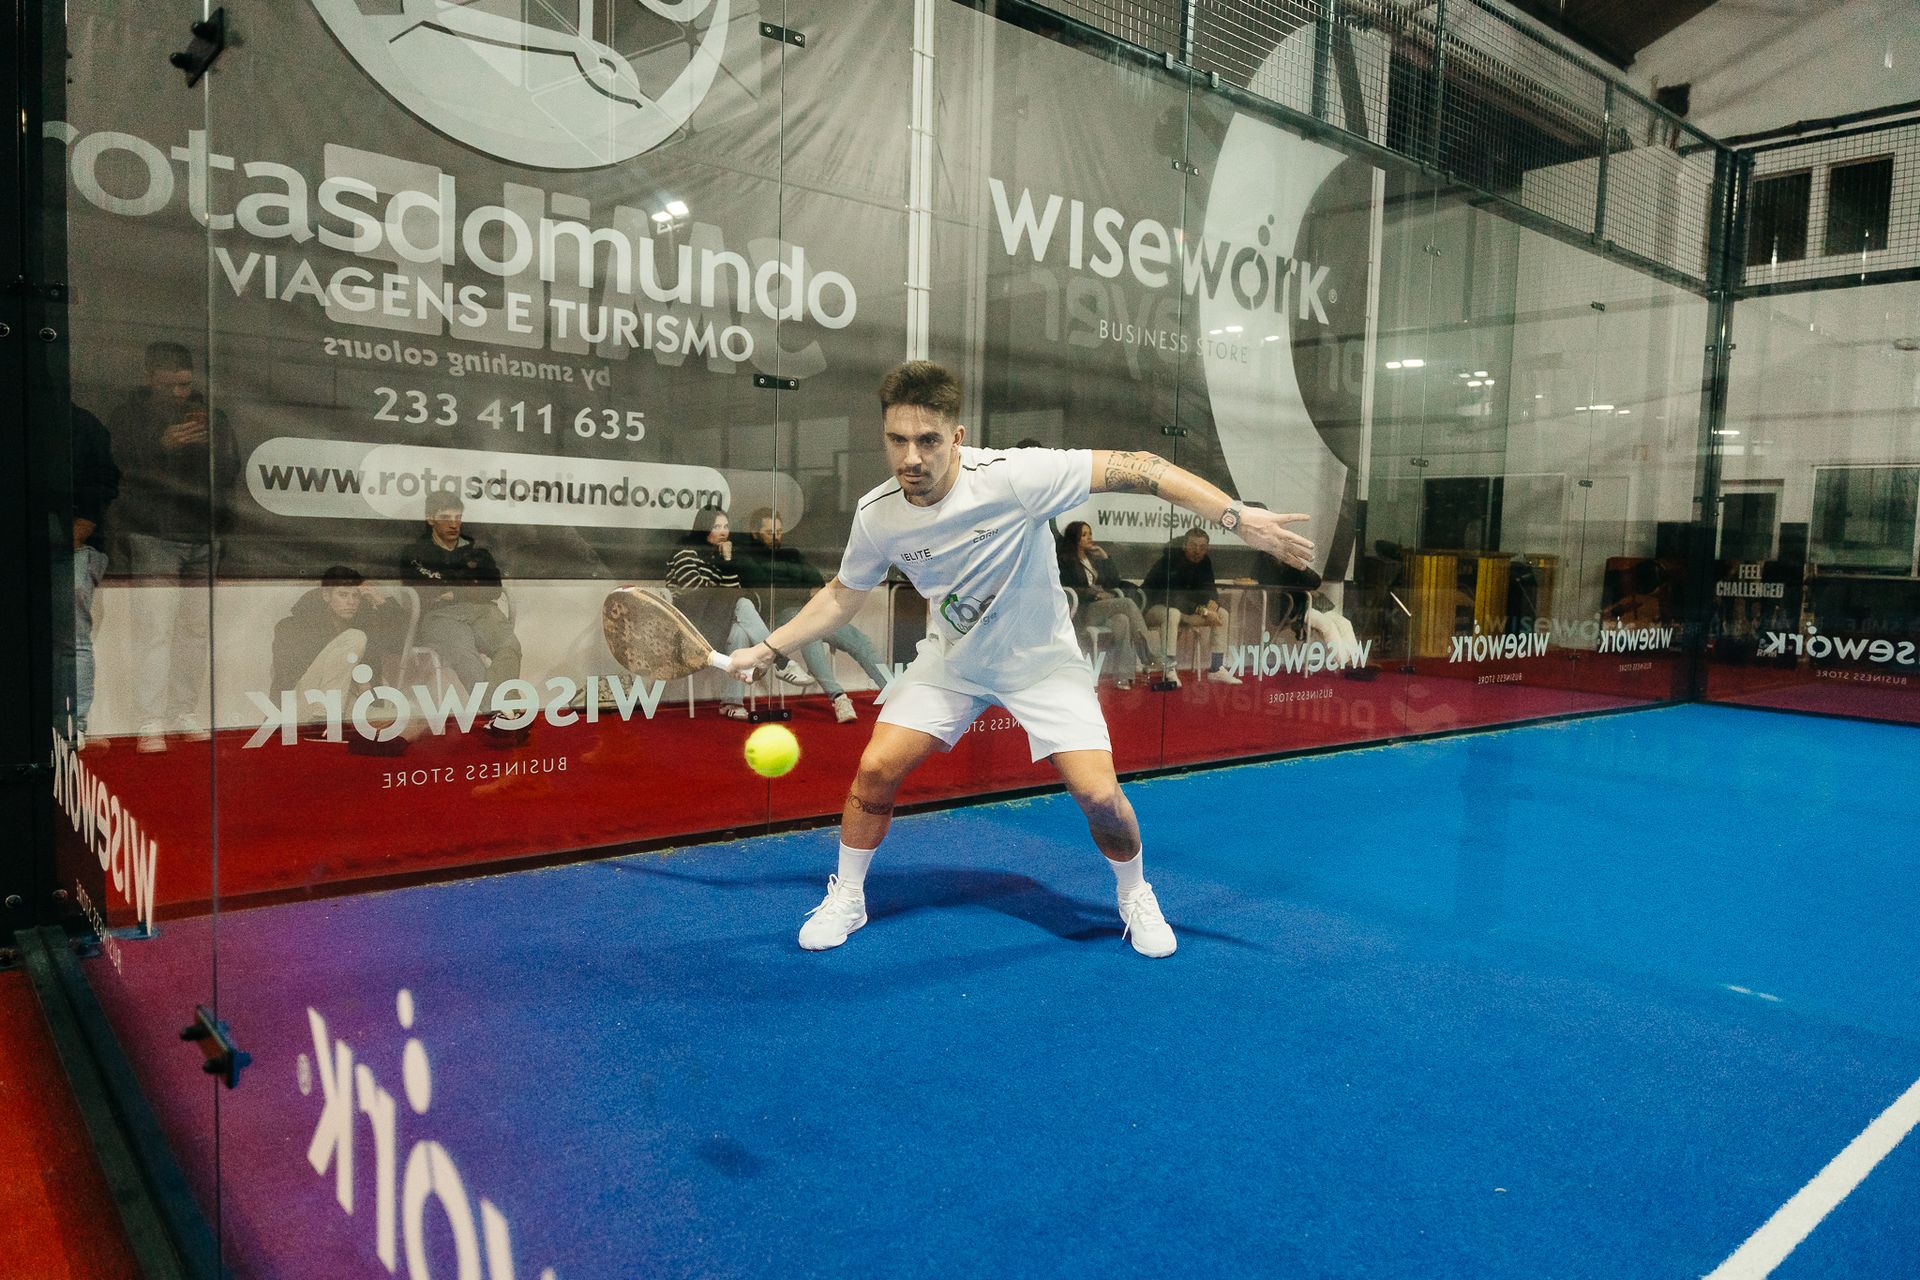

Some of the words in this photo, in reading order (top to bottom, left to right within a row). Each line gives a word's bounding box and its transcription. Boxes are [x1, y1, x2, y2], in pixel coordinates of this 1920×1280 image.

[42, 120, 857, 330] rotasdomundo
[214, 247, 488, 328] VIAGENS
[507, 292, 533, 334] E
[549, 298, 755, 363] TURISMO
[1099, 319, 1188, 353] BUSINESS
[1196, 338, 1249, 365] STORE
[373, 386, 459, 426] 233
[477, 400, 555, 434] 411
[574, 406, 646, 441] 635
[258, 460, 724, 512] www.rotasdomundo.com
[1097, 506, 1226, 535] www.wisework.
[1715, 581, 1785, 599] CHALLENGED
[1738, 564, 1763, 580] FEEL
